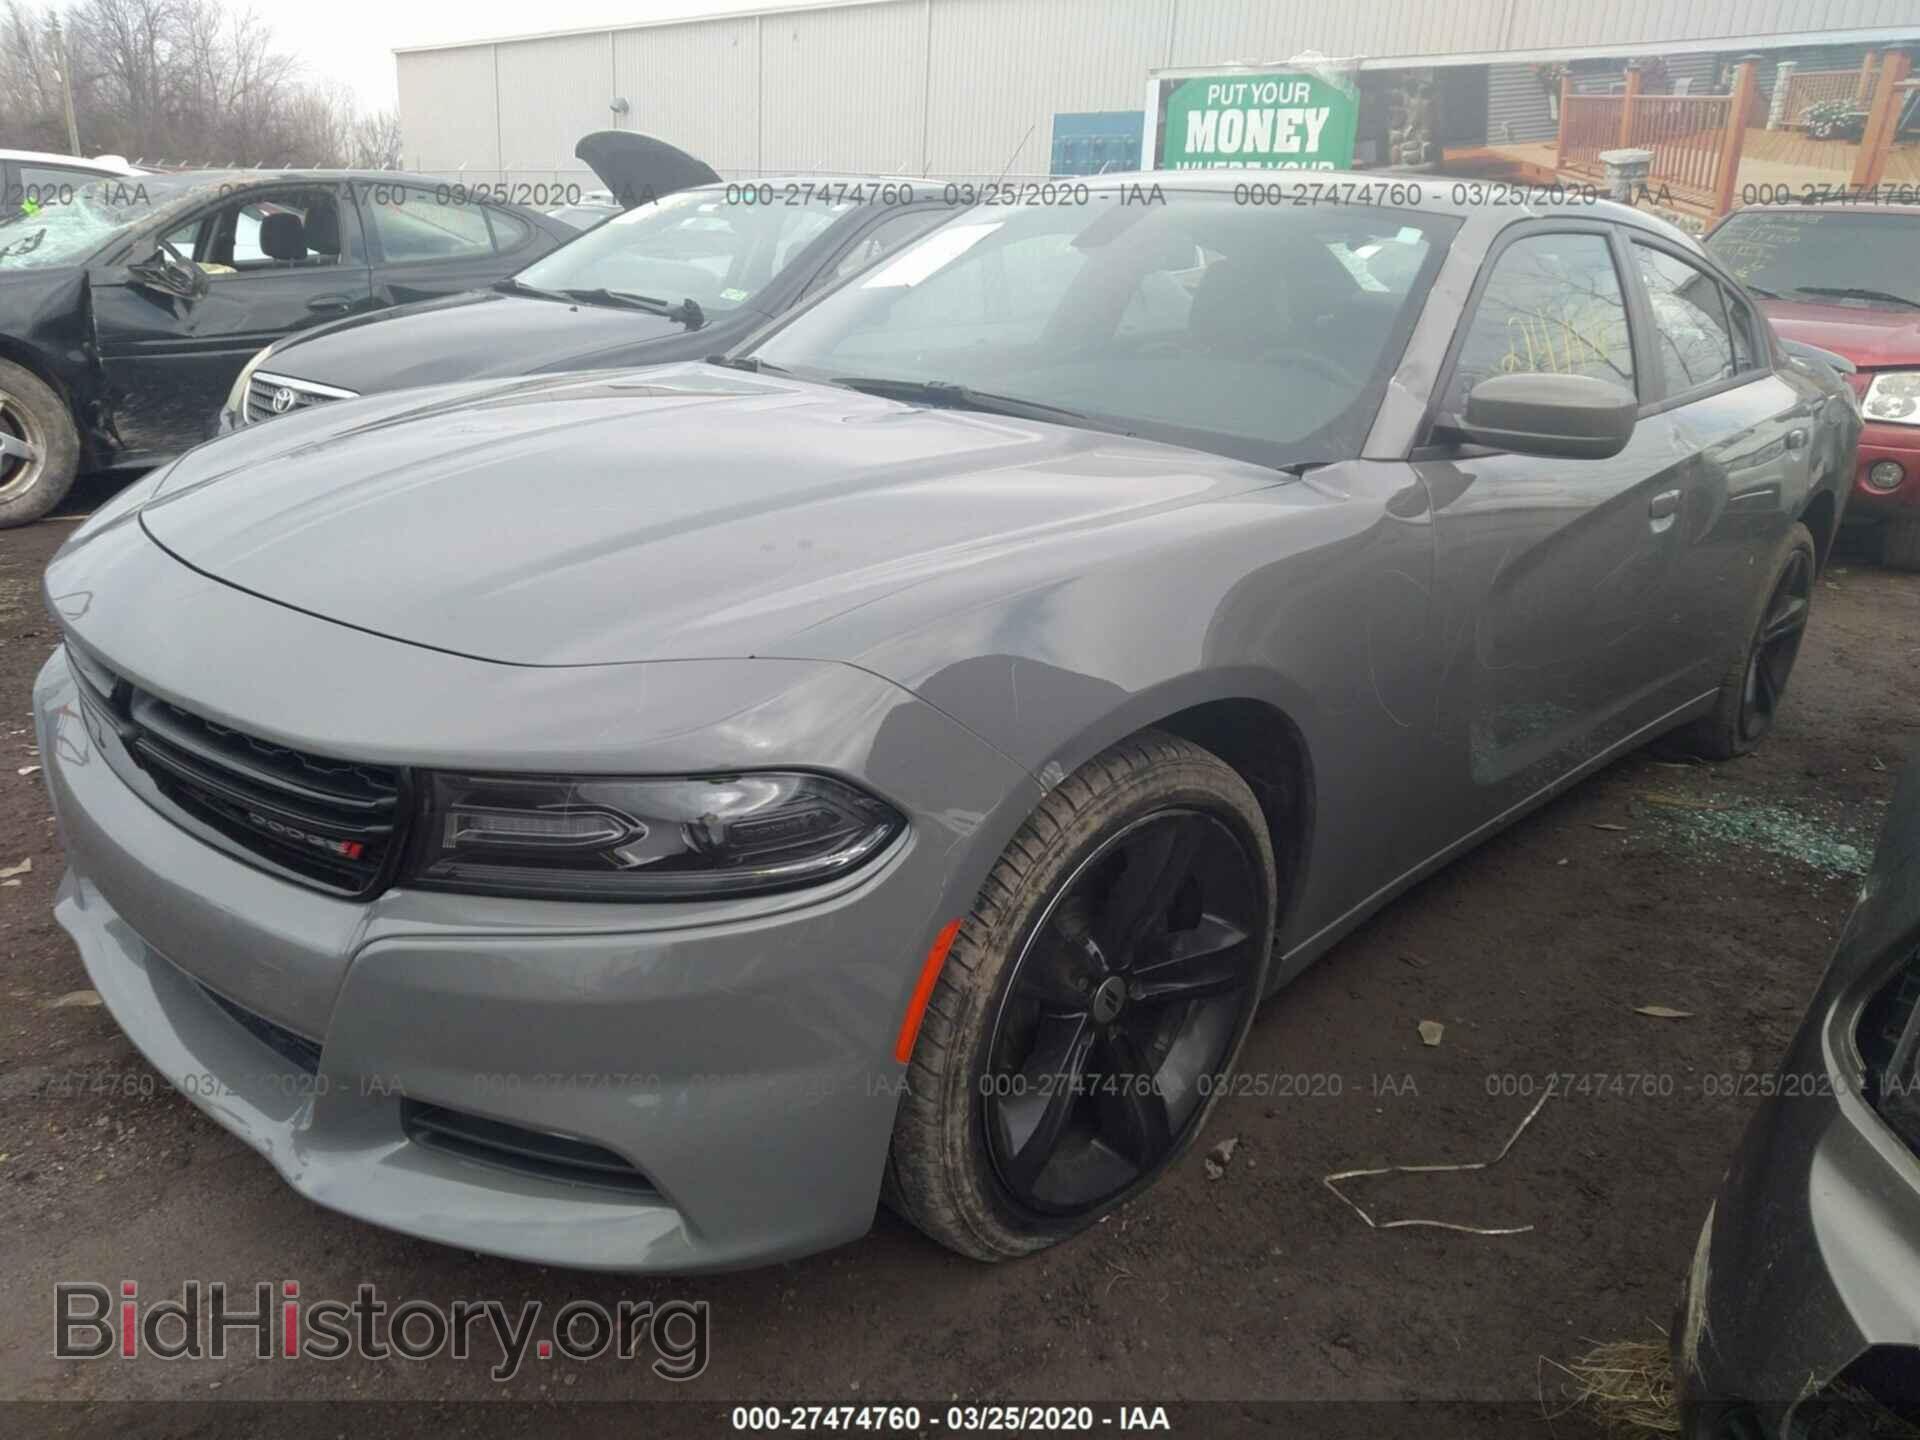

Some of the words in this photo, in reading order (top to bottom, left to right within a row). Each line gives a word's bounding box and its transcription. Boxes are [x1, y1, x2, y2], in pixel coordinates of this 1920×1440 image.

[1207, 84, 1249, 106] PUT
[1250, 82, 1311, 105] YOUR
[1184, 107, 1331, 153] MONEY
